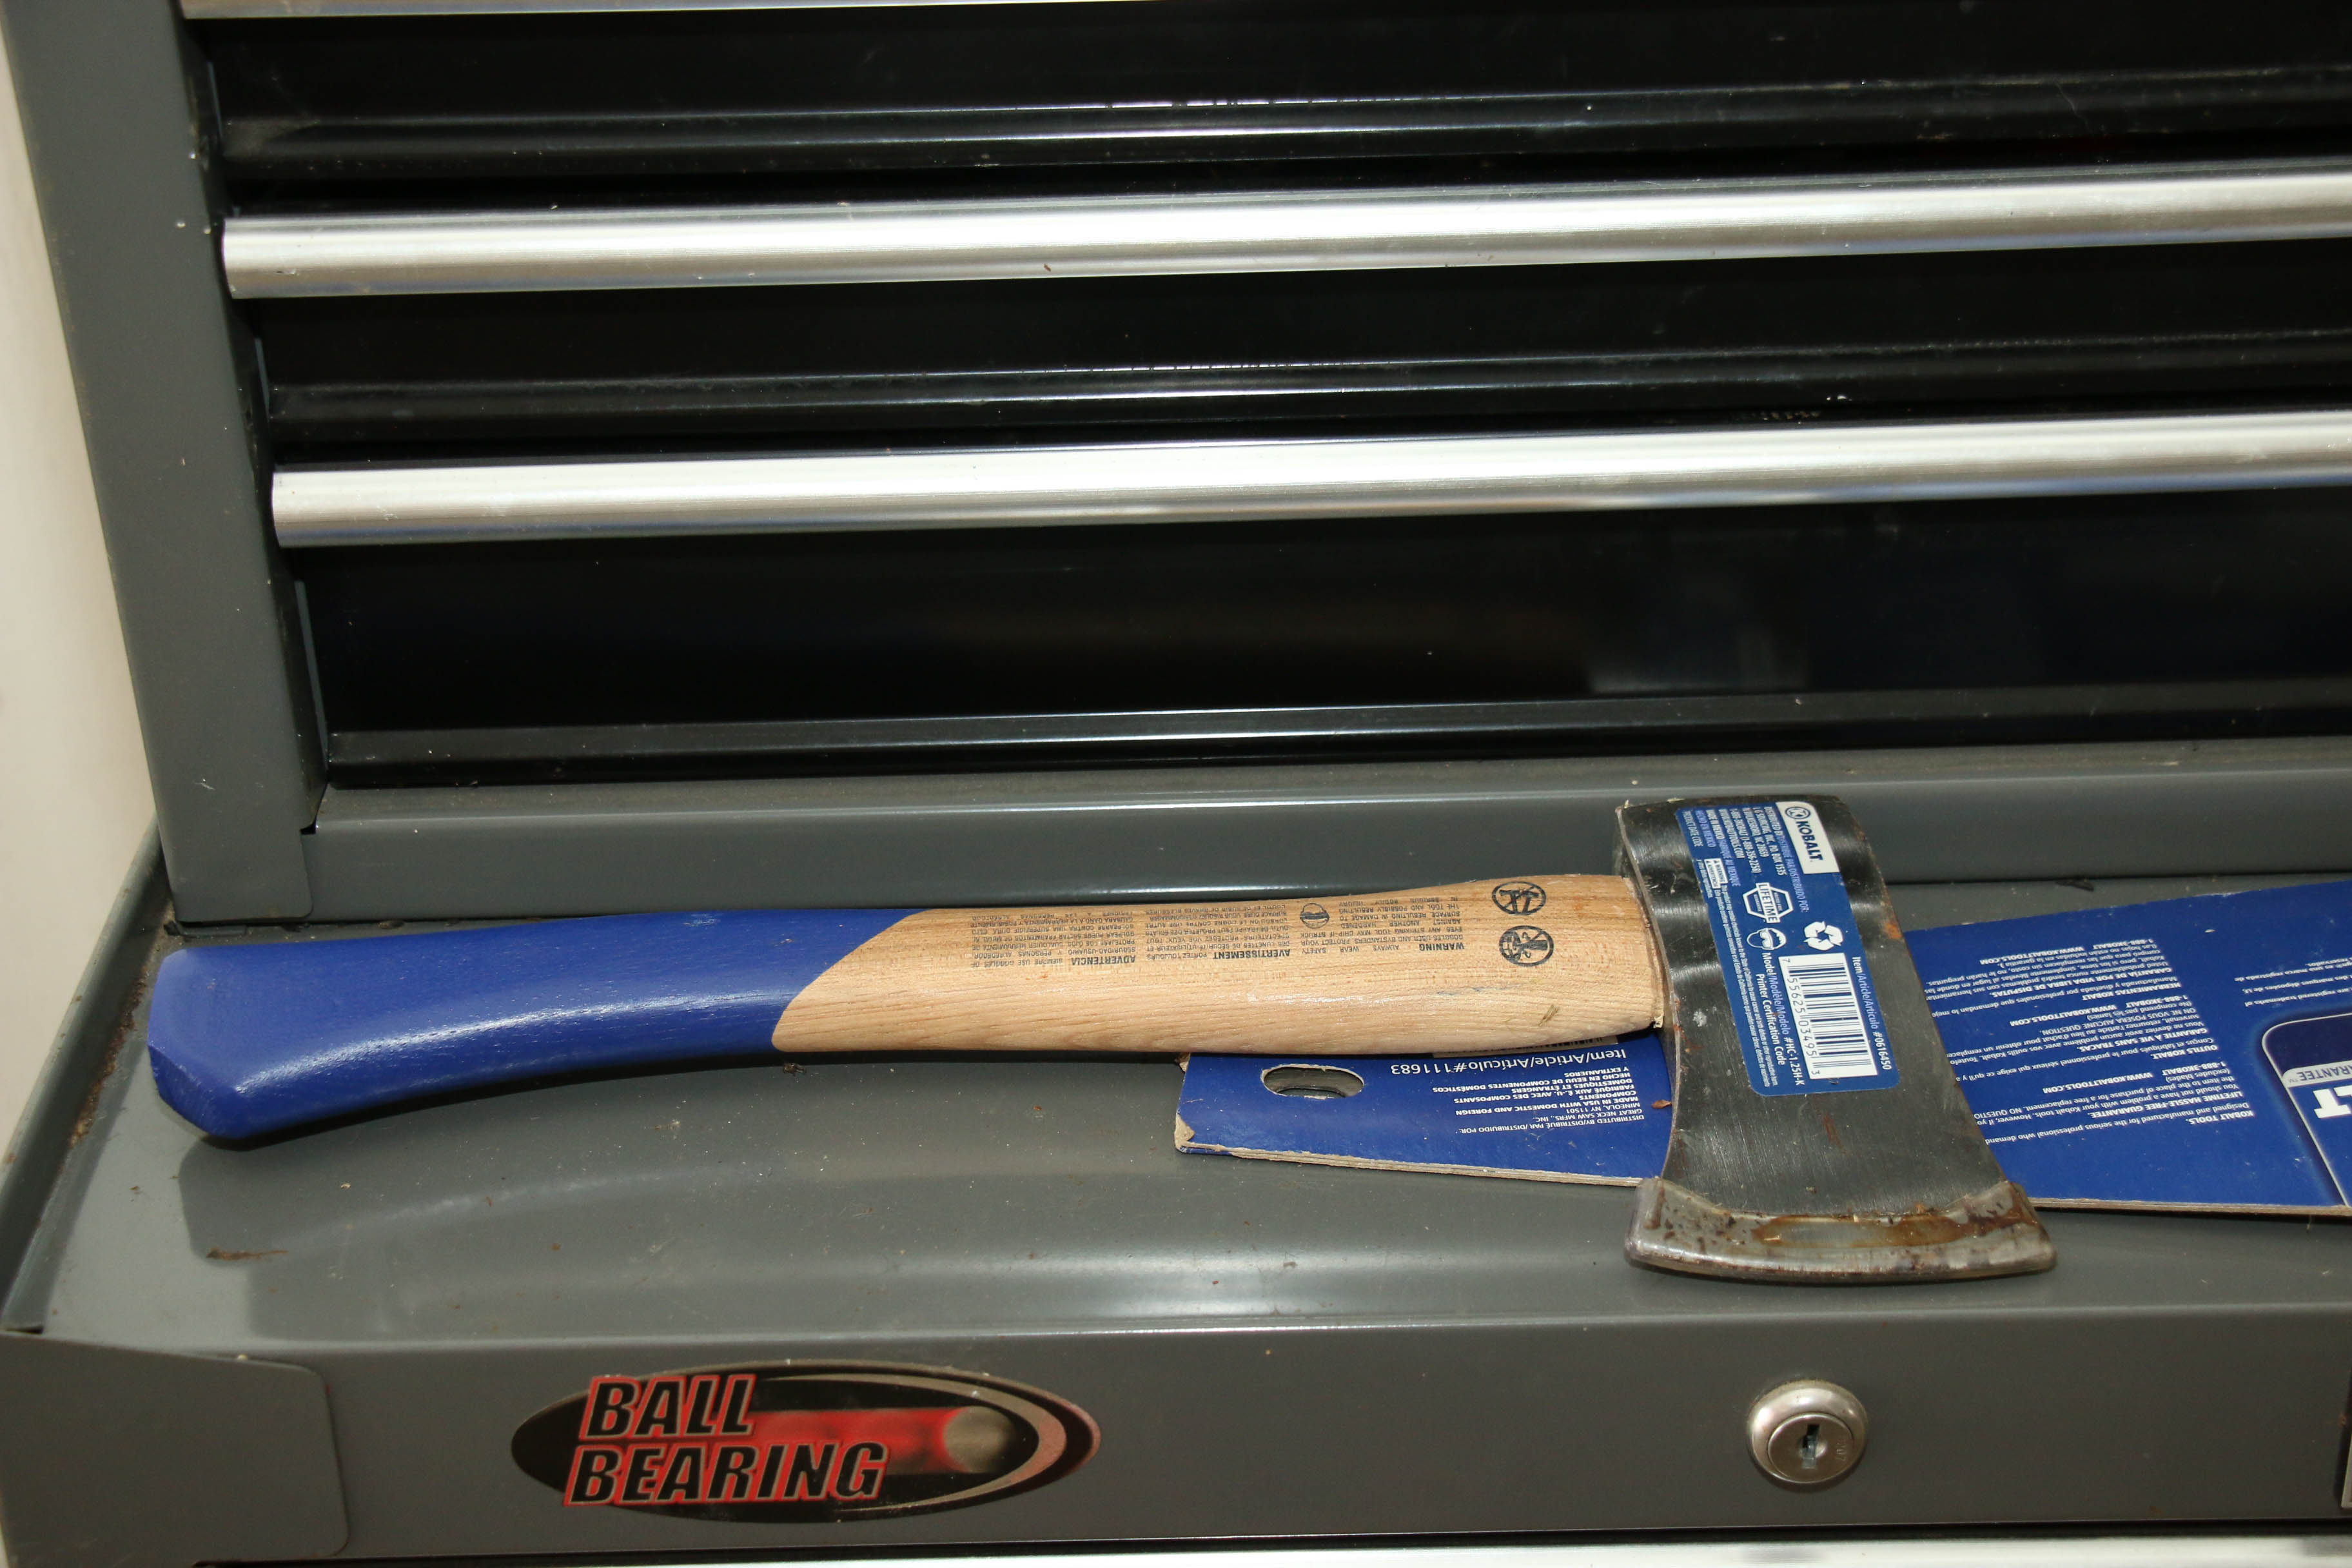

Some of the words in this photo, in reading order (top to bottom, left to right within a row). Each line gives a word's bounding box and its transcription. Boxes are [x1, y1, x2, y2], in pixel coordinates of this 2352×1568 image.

[1796, 821, 1823, 861] KOBALT
[1770, 854, 1782, 863] BOX
[1774, 864, 1787, 875] 1535
[1759, 884, 1778, 921] LIFETIME
[1418, 942, 1464, 950] WARNING
[1212, 949, 1291, 959] AVERTISSEMENT
[1071, 955, 1135, 965] ADVERTENCIA
[1755, 974, 1770, 997] Printer
[2114, 983, 2180, 995] HERRAMIENTAS
[2081, 992, 2114, 1000] KOBALT
[1761, 1000, 1782, 1044] Certification
[1787, 978, 1805, 1014] 55625
[1798, 1020, 1816, 1056] 03495
[2162, 1028, 2207, 1039] GARANTIE
[1872, 1032, 1892, 1069] #0616450
[2075, 1041, 2113, 1052] TRACAS.
[2186, 1044, 2217, 1054] OUTILS
[1774, 1046, 1787, 1064] Code
[2150, 1049, 2186, 1059] KOBALT.
[1389, 1049, 1626, 1074] Item/Article/Artículo#111683
[1783, 1037, 1805, 1085] #HC-1.25H-K
[1563, 1067, 1621, 1077] EXTRANJEROS
[2160, 1061, 2226, 1075] 1-888-3KOBALT
[2193, 1068, 2231, 1078] (excludes
[1572, 1077, 1632, 1087] DOMESTIQUES
[2041, 1072, 2153, 1093] WWW.KOBALTTOOLS.COM
[2164, 1073, 2193, 1082] blades)
[1487, 1079, 1549, 1088] COMPONENTES
[2153, 1083, 2177, 1092] place
[1578, 1090, 1636, 1099] COMPONENTS
[2108, 1088, 2145, 1099] purchase
[2194, 1085, 2222, 1094] should
[1453, 1094, 1511, 1102] COMPOSANTS
[2117, 1094, 2152, 1105] problem
[2201, 1091, 2242, 1101] LIFETIME
[2022, 1098, 2073, 1112] replacement.
[2144, 1097, 2202, 1110] HASSLE-FREE
[2211, 1101, 2249, 1112] Designed
[1972, 1108, 2008, 1119] QUESTIO
[2031, 1110, 2055, 1118] tools.
[2054, 1106, 2081, 1115] Kobalt
[2086, 1105, 2144, 1118] GUARANTEE.
[2140, 1110, 2195, 1122] manufactured
[2218, 1110, 2254, 1120] KOBALT
[1596, 1114, 1644, 1122] DISTRIBUTED
[1994, 1112, 2032, 1123] However,
[2184, 1115, 2218, 1124] TOOLS.
[2035, 1124, 2084, 1137] professional
[2084, 1121, 2113, 1130] serious
[1984, 1135, 2017, 1144] demand
[579, 1375, 756, 1440] BALL
[564, 1440, 890, 1506] BEARING
